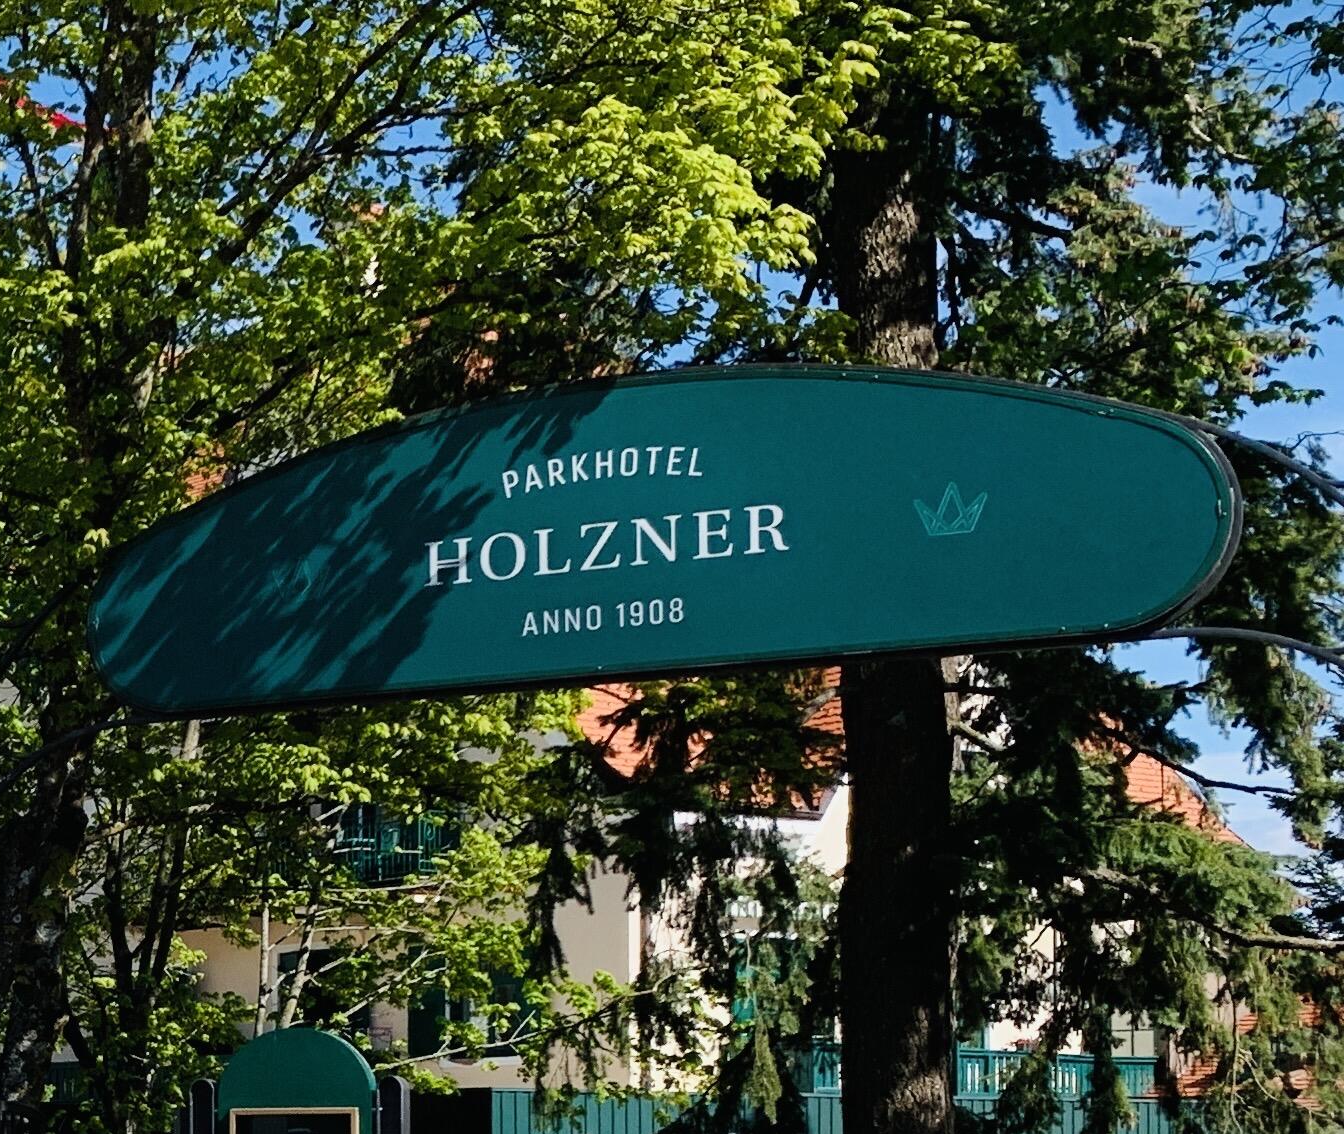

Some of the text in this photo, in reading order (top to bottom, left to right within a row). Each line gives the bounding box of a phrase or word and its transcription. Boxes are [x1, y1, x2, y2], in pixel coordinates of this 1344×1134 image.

[501, 446, 703, 499] PARKHOTEL
[423, 503, 790, 588] HOLZNER
[521, 597, 685, 637] ANNO 1908
